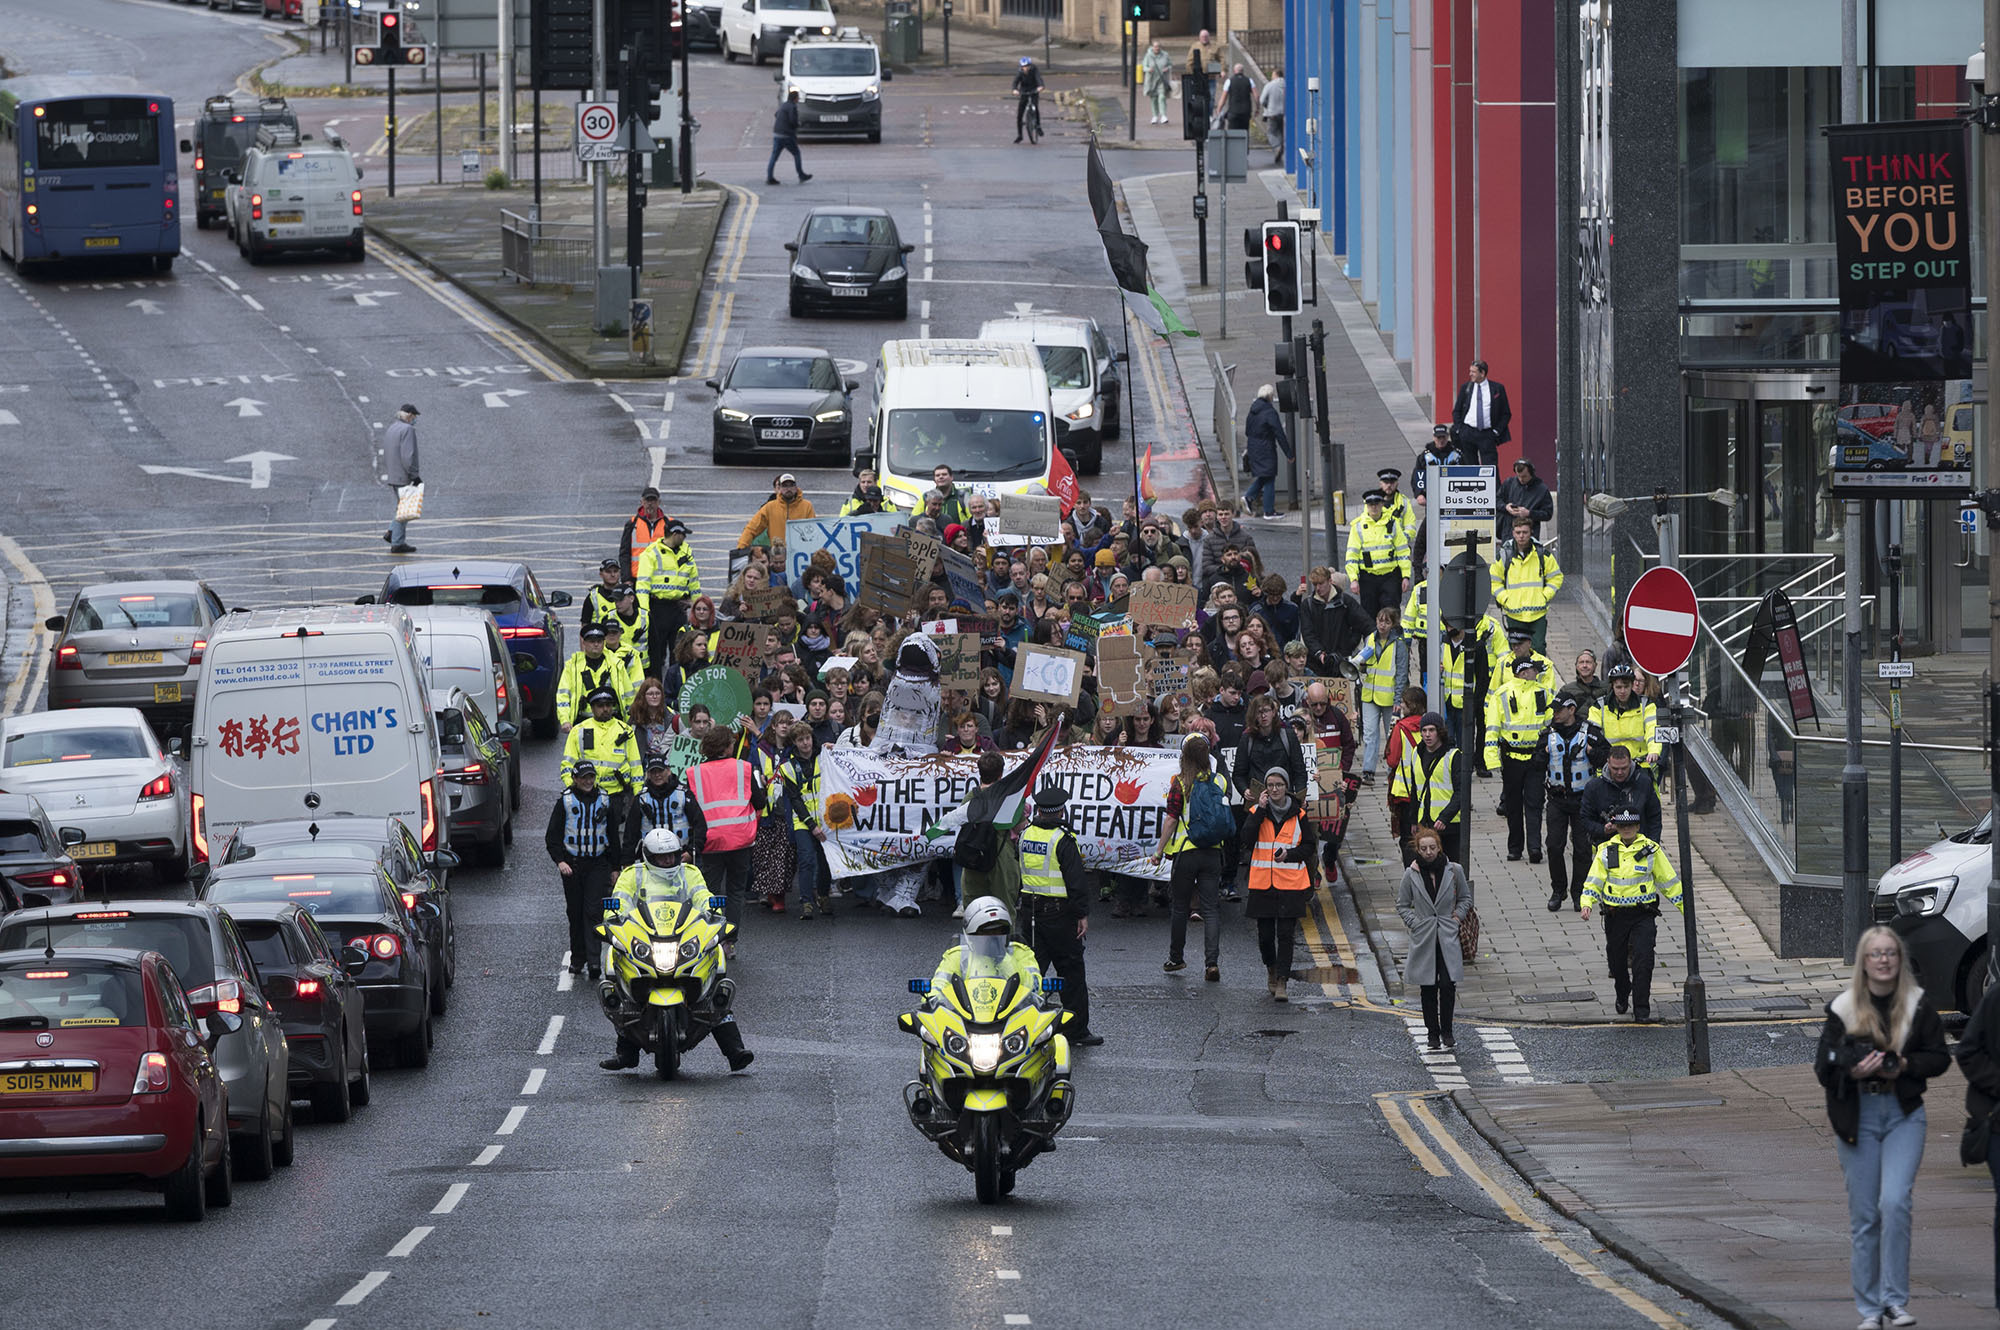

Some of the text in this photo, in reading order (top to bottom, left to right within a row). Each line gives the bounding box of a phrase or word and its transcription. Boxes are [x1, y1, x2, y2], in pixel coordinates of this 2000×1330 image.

[586, 116, 610, 130] 30
[95, 132, 139, 144] Glasgow
[1846, 184, 1955, 208] BEFORE
[1846, 211, 1956, 253] YOU
[1850, 260, 1960, 280] STEP OUT
[1445, 496, 1489, 505] Bus Stop
[724, 624, 755, 645] Only
[215, 663, 299, 676] TEL: 0141 332 3032
[329, 660, 363, 668] FARNELL
[1784, 663, 1792, 673] WE
[214, 672, 301, 685] www.chansltd.co.uk
[318, 668, 356, 677] GLASGOW
[705, 668, 727, 681] FOR
[1787, 674, 1807, 693] OPEN
[680, 672, 704, 714] FRIDAYS
[311, 706, 398, 735] CHAN'S
[334, 734, 374, 756] LTD
[876, 778, 926, 804] THE
[935, 777, 981, 804] PEO
[851, 804, 912, 834] WILL
[89, 844, 111, 855] LLE
[1023, 842, 1047, 854] POLICE
[50, 1074, 82, 1089] NMM
